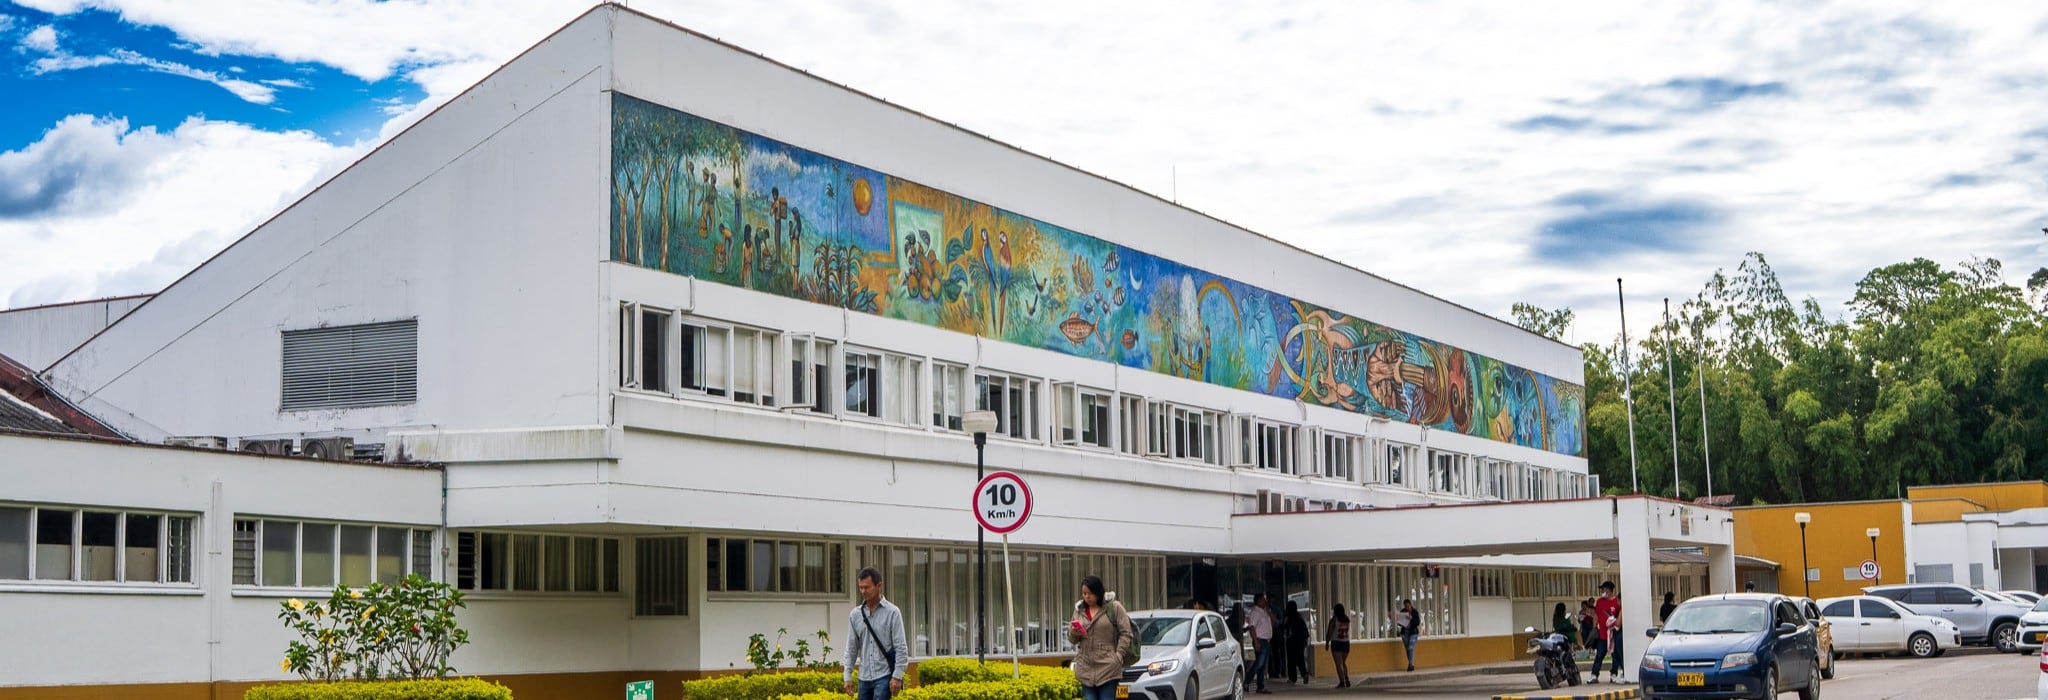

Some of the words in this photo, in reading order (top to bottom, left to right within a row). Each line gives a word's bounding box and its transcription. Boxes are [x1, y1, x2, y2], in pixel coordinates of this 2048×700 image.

[985, 483, 1016, 506] 10
[987, 509, 1016, 519] Km/h
[1864, 564, 1874, 572] 10
